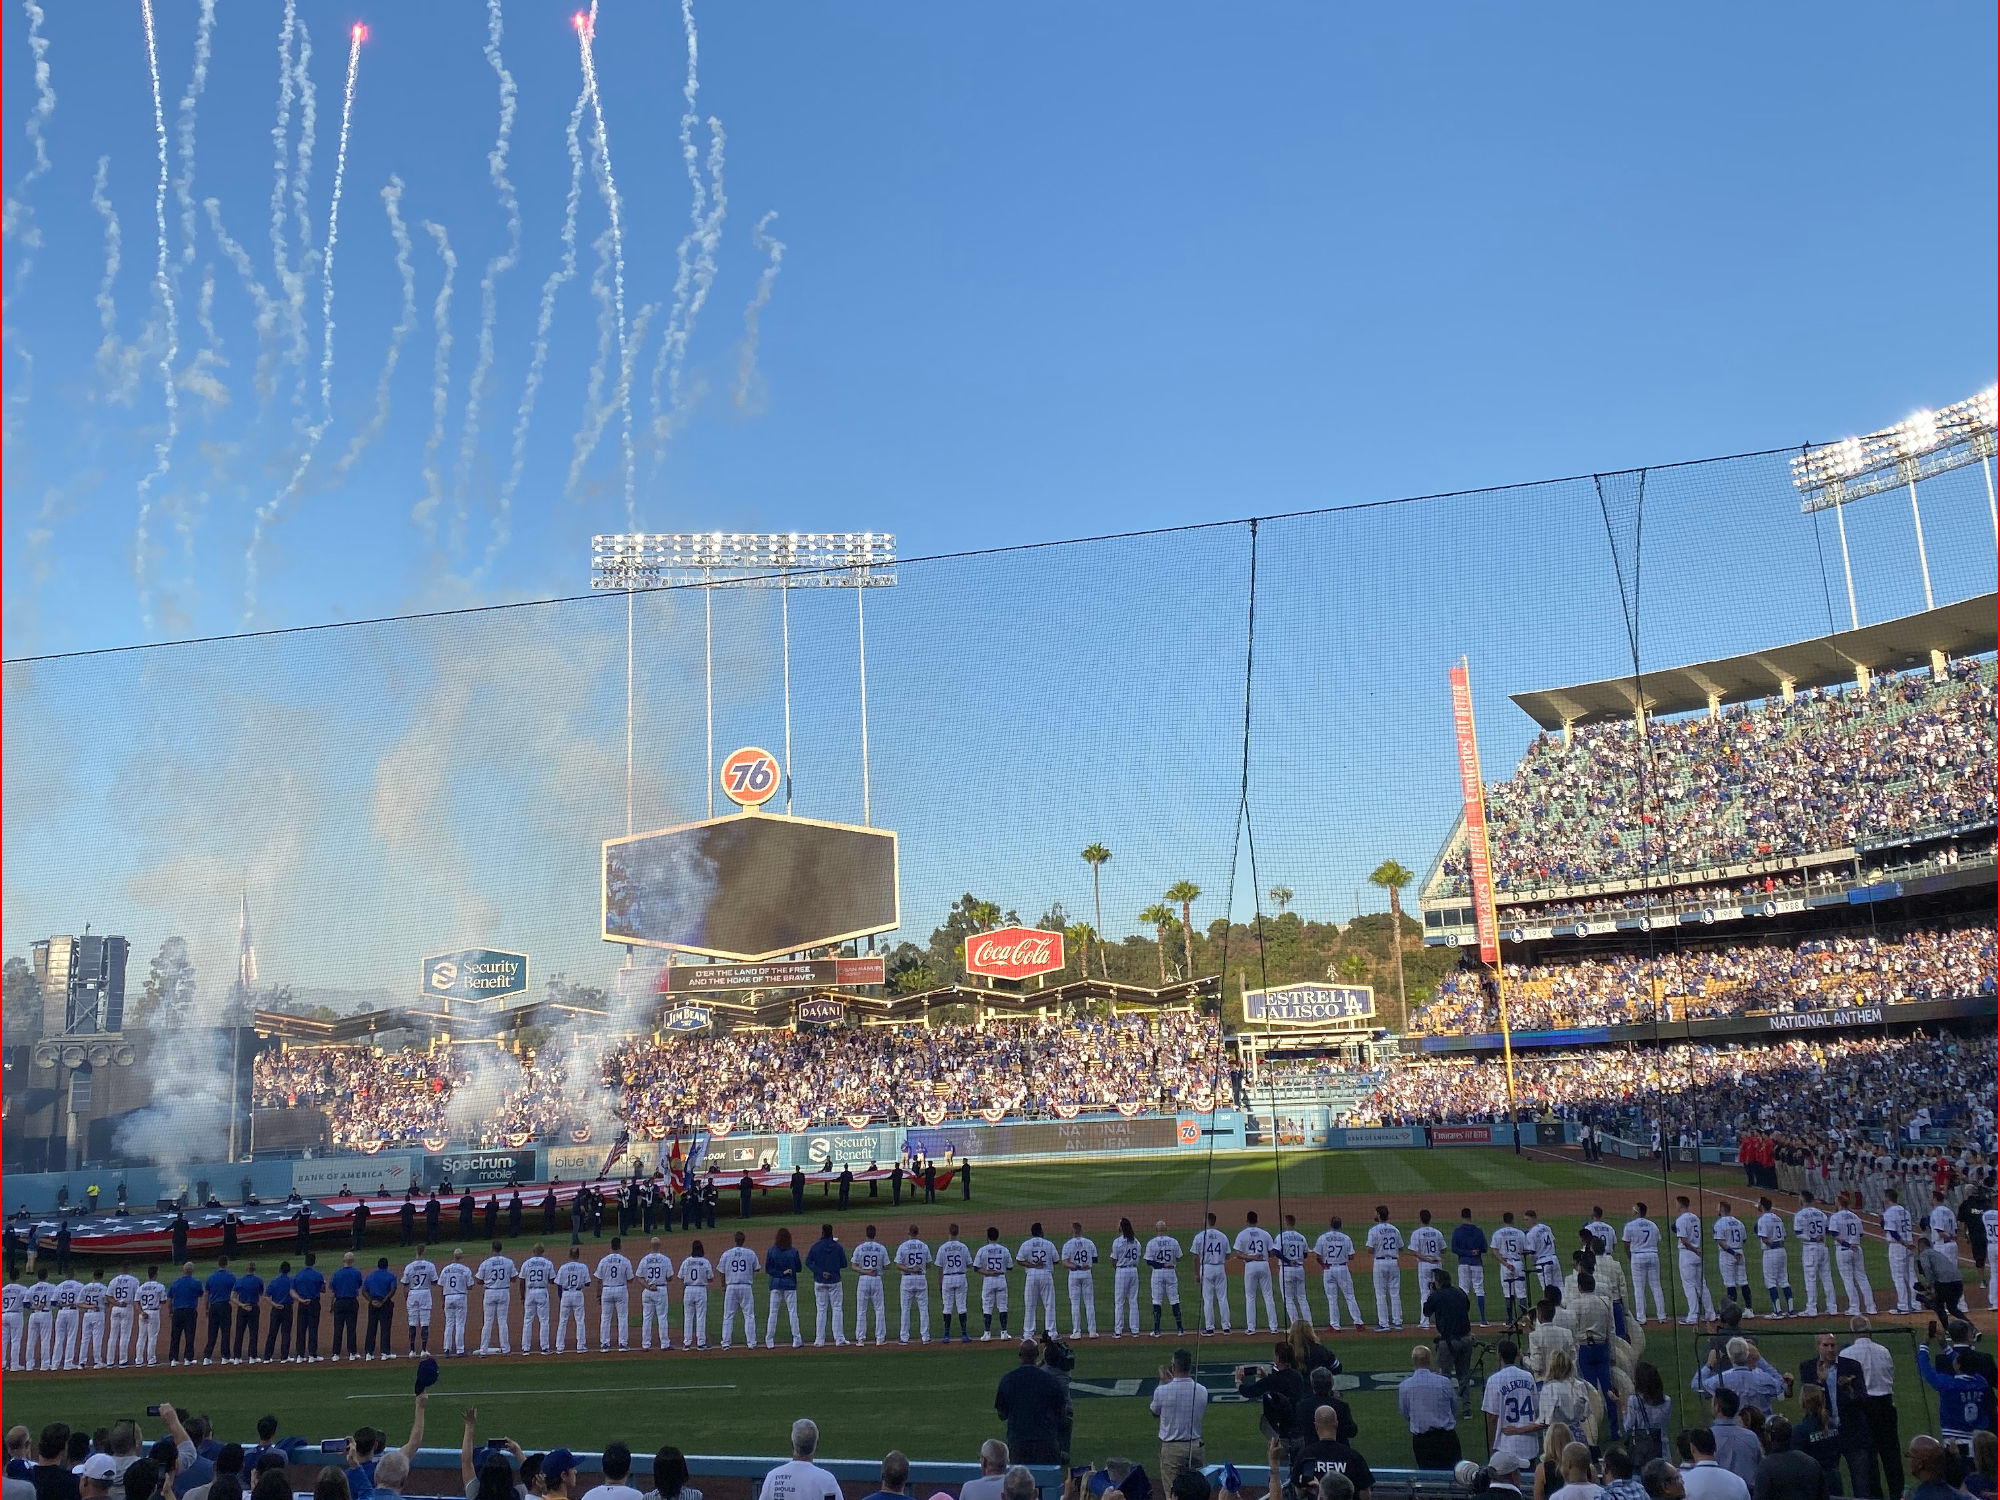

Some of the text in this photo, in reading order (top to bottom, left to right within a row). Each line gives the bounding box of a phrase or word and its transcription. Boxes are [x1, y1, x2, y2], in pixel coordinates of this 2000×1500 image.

[1457, 719, 1471, 735] FLY
[729, 757, 773, 792] 76
[1460, 738, 1479, 803] Emirates
[1513, 858, 1798, 901] DODGER STADIUM CLUB
[1476, 882, 1495, 948] Emirates
[974, 938, 1054, 967] Coca-Cola
[464, 960, 519, 975] Security
[464, 975, 511, 989] Benefit
[708, 977, 725, 985] THE
[726, 976, 751, 984] HOME
[783, 974, 815, 982] BRAVE?
[666, 1008, 706, 1027] JIM BEAM
[802, 1006, 840, 1018] DASANI
[1257, 1004, 1339, 1018] JALISCO
[1770, 1008, 1882, 1030] NATIONAL ANTHEM
[1181, 1126, 1196, 1138] 76
[834, 1136, 878, 1150] Security
[835, 1147, 873, 1161] Benefit
[442, 1156, 512, 1174] Spectrum
[555, 1156, 583, 1168] blue
[298, 1170, 383, 1182] BANK OF AMERICA
[478, 1168, 512, 1180] mobile
[1776, 1226, 1782, 1238] 3
[1809, 1221, 1823, 1234] 35
[1847, 1223, 1857, 1236] 10
[1642, 1230, 1650, 1243] 7
[1731, 1229, 1740, 1242] 13
[1207, 1242, 1221, 1255] 44
[1249, 1240, 1263, 1253] 43
[1382, 1237, 1396, 1250] 22
[1425, 1240, 1436, 1253] 18
[1505, 1239, 1517, 1252] 15
[1031, 1250, 1047, 1263] 52
[1073, 1250, 1088, 1263] 48
[1124, 1248, 1138, 1261] 46
[1156, 1250, 1171, 1262] 45
[1289, 1244, 1300, 1257] 31
[1328, 1245, 1343, 1258] 27
[863, 1255, 878, 1267] 68
[908, 1252, 923, 1265] 65
[947, 1255, 962, 1268] 56
[987, 1257, 1002, 1270] 55
[610, 1265, 617, 1278] 8
[731, 1259, 747, 1272] 99
[491, 1269, 505, 1281] 33
[529, 1269, 543, 1281] 29
[647, 1266, 661, 1279] 38
[691, 1268, 698, 1280] 0
[413, 1273, 427, 1286] 37
[450, 1276, 457, 1288] 6
[567, 1274, 578, 1287] 12
[61, 1292, 75, 1304] 98
[115, 1286, 128, 1298] 85
[3, 1297, 15, 1309] 97
[33, 1294, 47, 1306] 94
[85, 1295, 99, 1306] 95
[141, 1294, 155, 1306] 92
[1505, 1396, 1534, 1423] 34
[1315, 1461, 1347, 1473] REW
